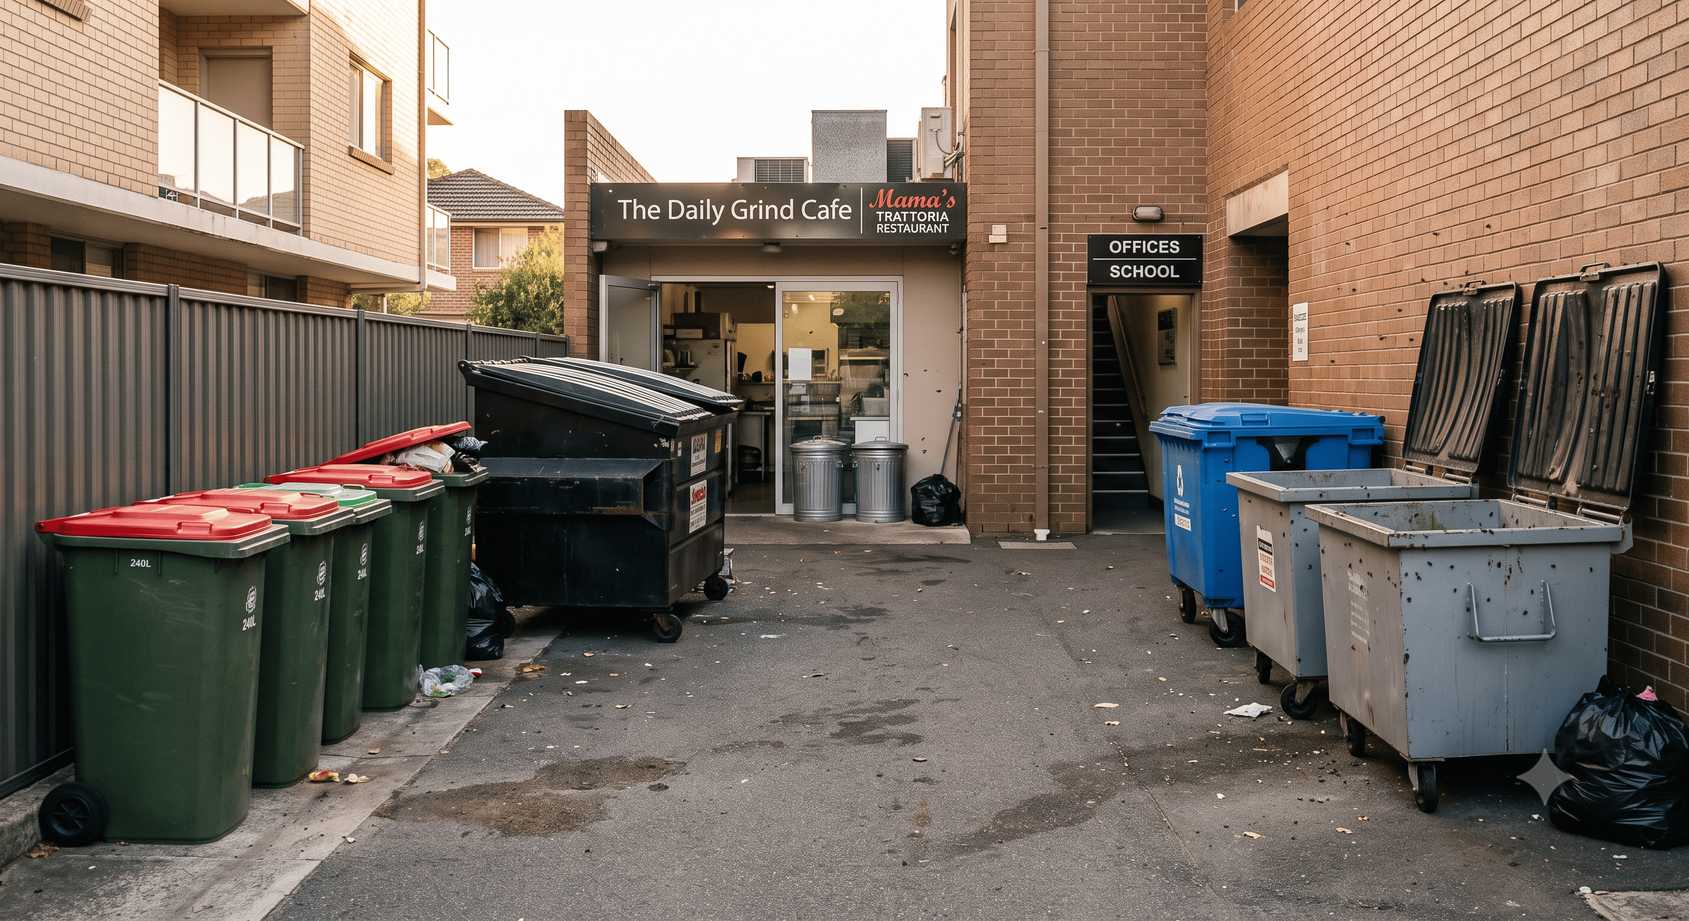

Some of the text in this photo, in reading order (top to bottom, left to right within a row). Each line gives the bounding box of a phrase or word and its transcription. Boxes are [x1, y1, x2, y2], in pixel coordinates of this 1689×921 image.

[868, 188, 957, 209] Mama's
[617, 198, 853, 226] The Daily Grind Cafe
[876, 211, 950, 222] TRATTORIA
[876, 223, 950, 234] RESTAURANT
[1109, 240, 1180, 254] OFFICES
[1109, 264, 1180, 278] SCHOOL
[129, 558, 152, 568] 240L
[242, 614, 257, 632] 240L
